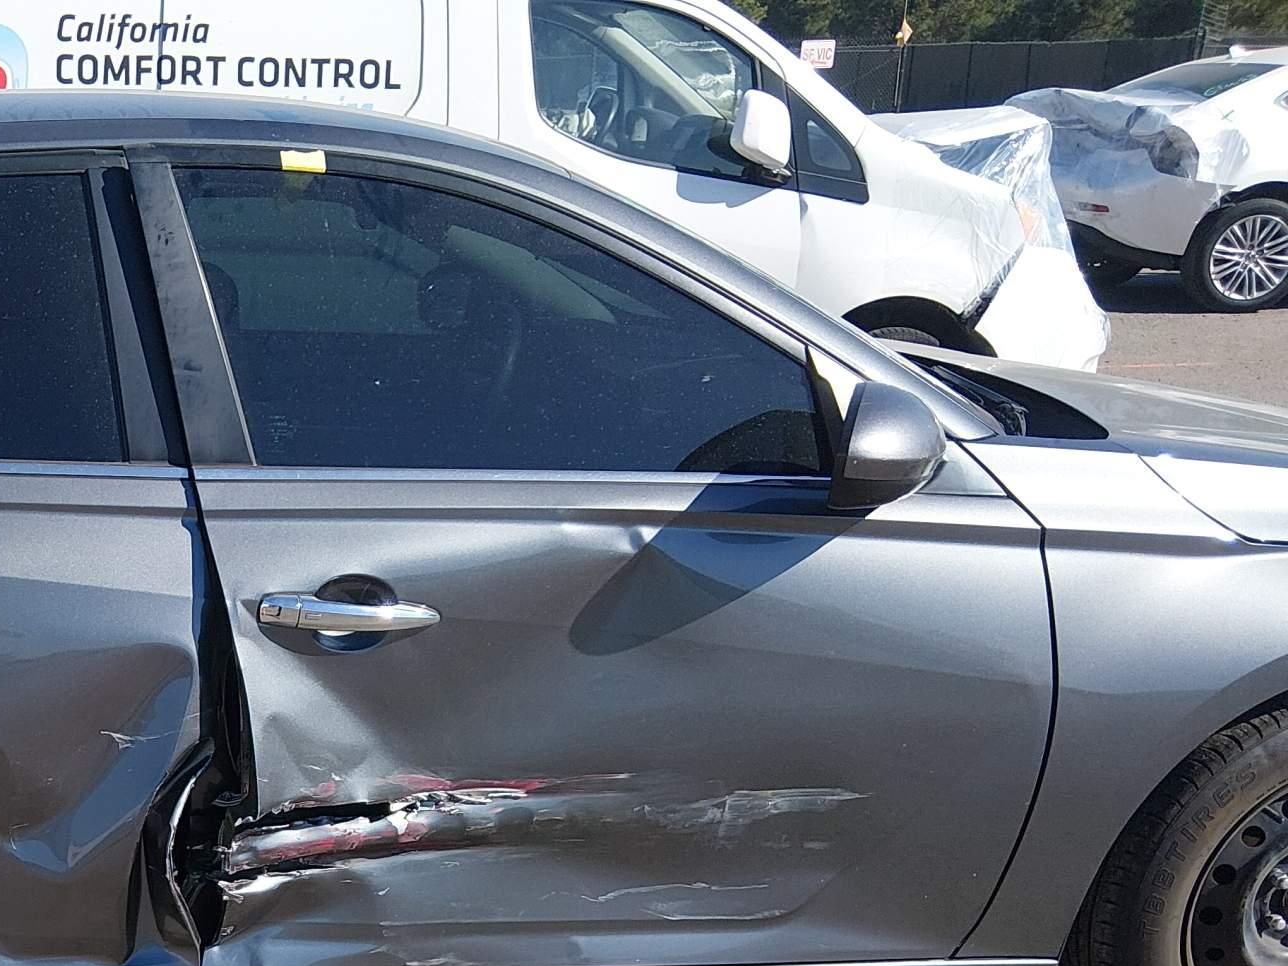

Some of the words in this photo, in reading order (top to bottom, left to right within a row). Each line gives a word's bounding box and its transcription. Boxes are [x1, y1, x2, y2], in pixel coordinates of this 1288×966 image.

[56, 14, 210, 50] California
[56, 54, 226, 86] COMFORT
[237, 57, 401, 90] CONTROL
